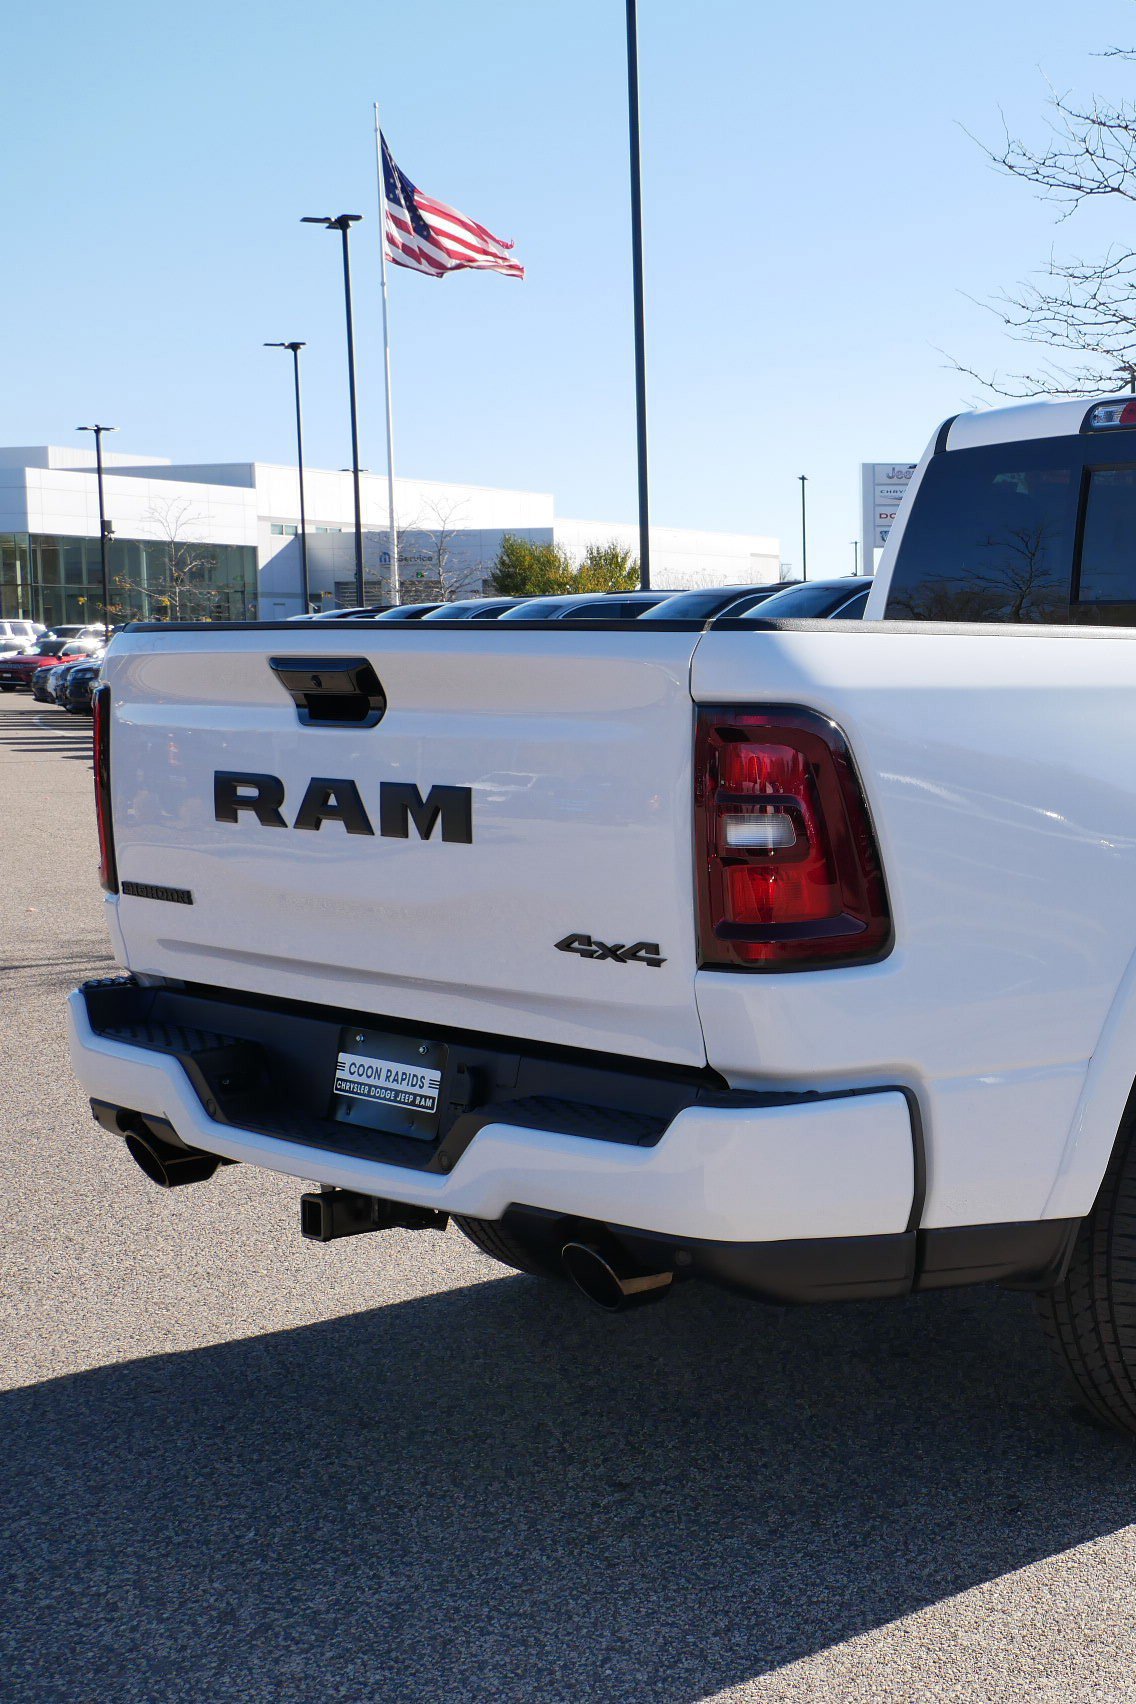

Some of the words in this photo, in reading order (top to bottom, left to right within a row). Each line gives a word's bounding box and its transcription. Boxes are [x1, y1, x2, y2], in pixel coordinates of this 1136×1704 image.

[886, 467, 914, 479] Jee
[214, 770, 472, 844] RAM
[348, 1062, 383, 1081] COON
[385, 1069, 426, 1090] RAPIDS
[336, 1080, 369, 1095] CHRYSLER
[370, 1087, 395, 1100] DODGE
[396, 1092, 414, 1103] JEEP
[415, 1097, 433, 1108] RAM
